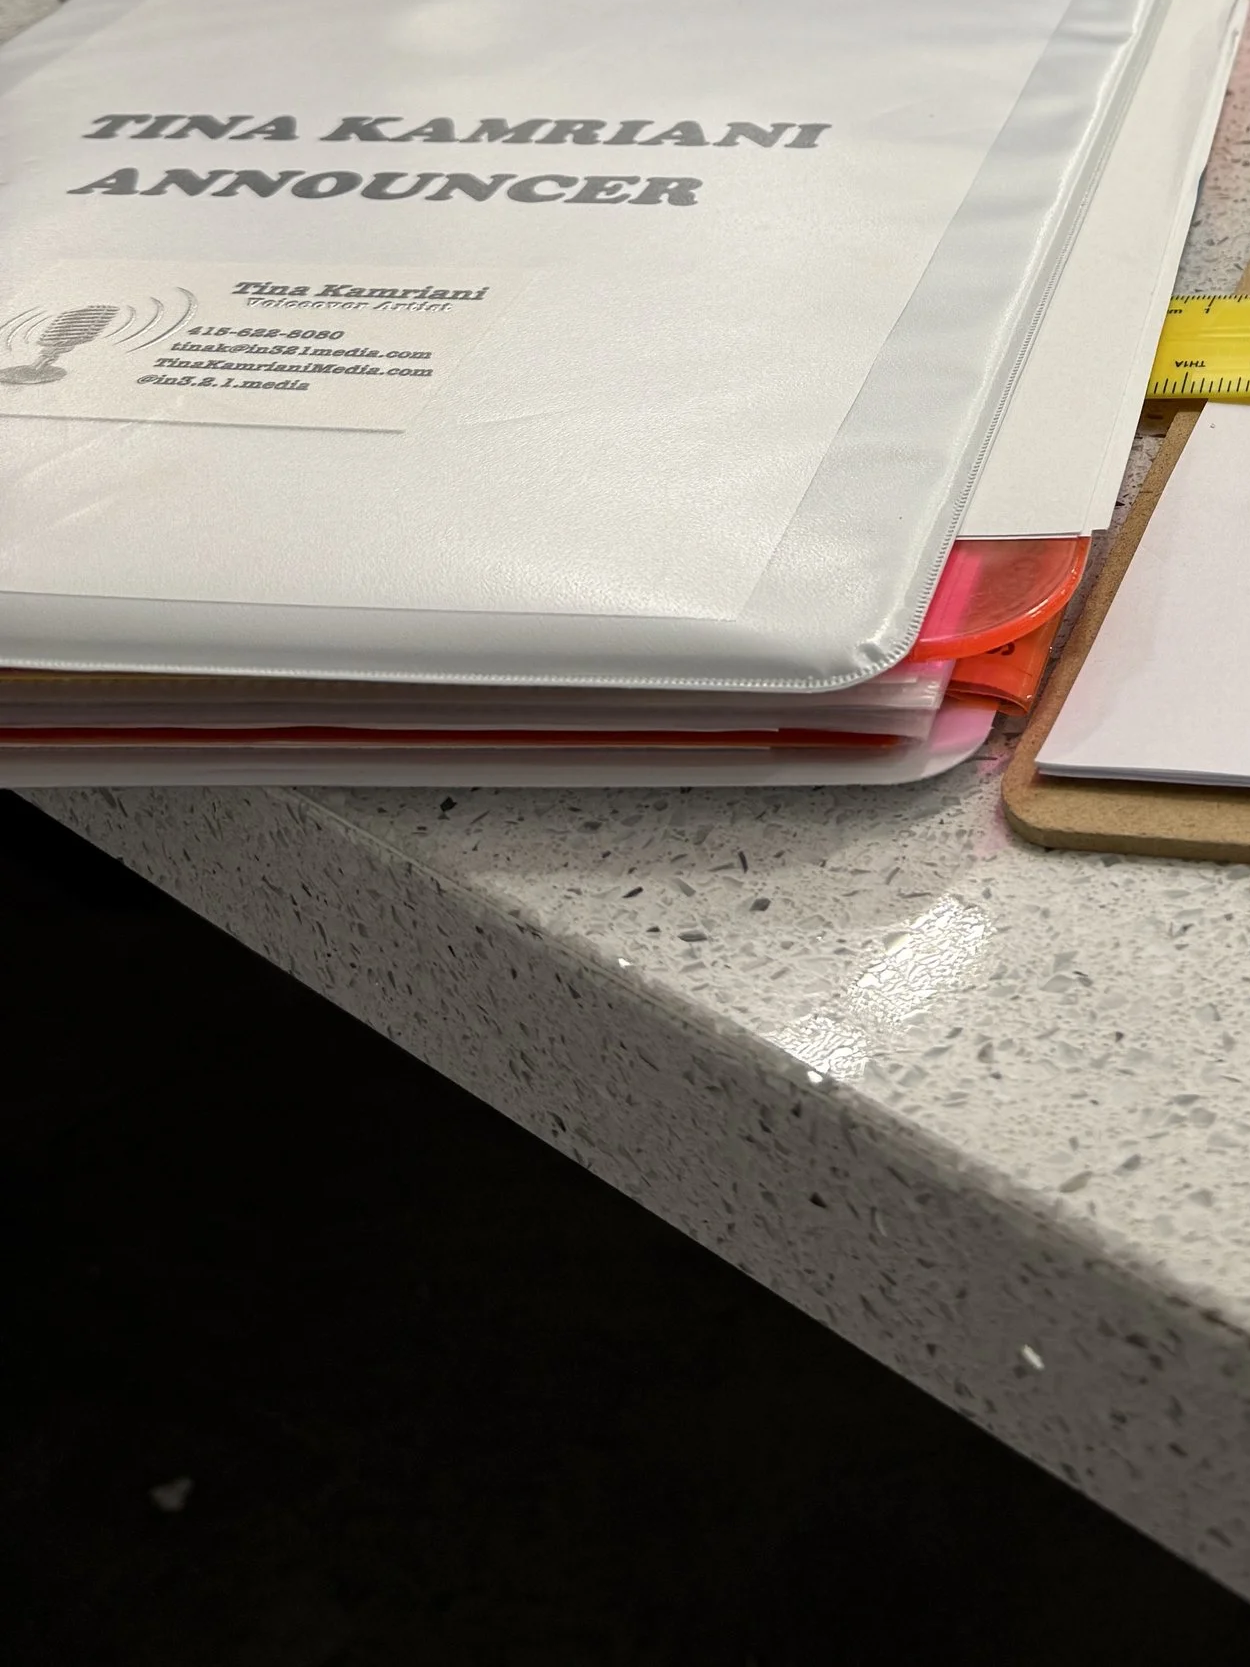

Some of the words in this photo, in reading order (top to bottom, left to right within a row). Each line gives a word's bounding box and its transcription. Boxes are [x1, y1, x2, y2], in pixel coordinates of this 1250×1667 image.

[82, 113, 300, 141] TINA
[319, 115, 832, 149] KAMRIANI
[66, 166, 704, 207] ANNOUNCER
[232, 281, 309, 297] Tina
[314, 283, 491, 301] Kamriani
[247, 297, 369, 311] Voiceover
[372, 300, 453, 313] Artist
[169, 341, 433, 360] tinak@in321media.com
[153, 357, 434, 378] TinaKamrianiMedia.com
[136, 374, 311, 392] @in3.2.1.media
